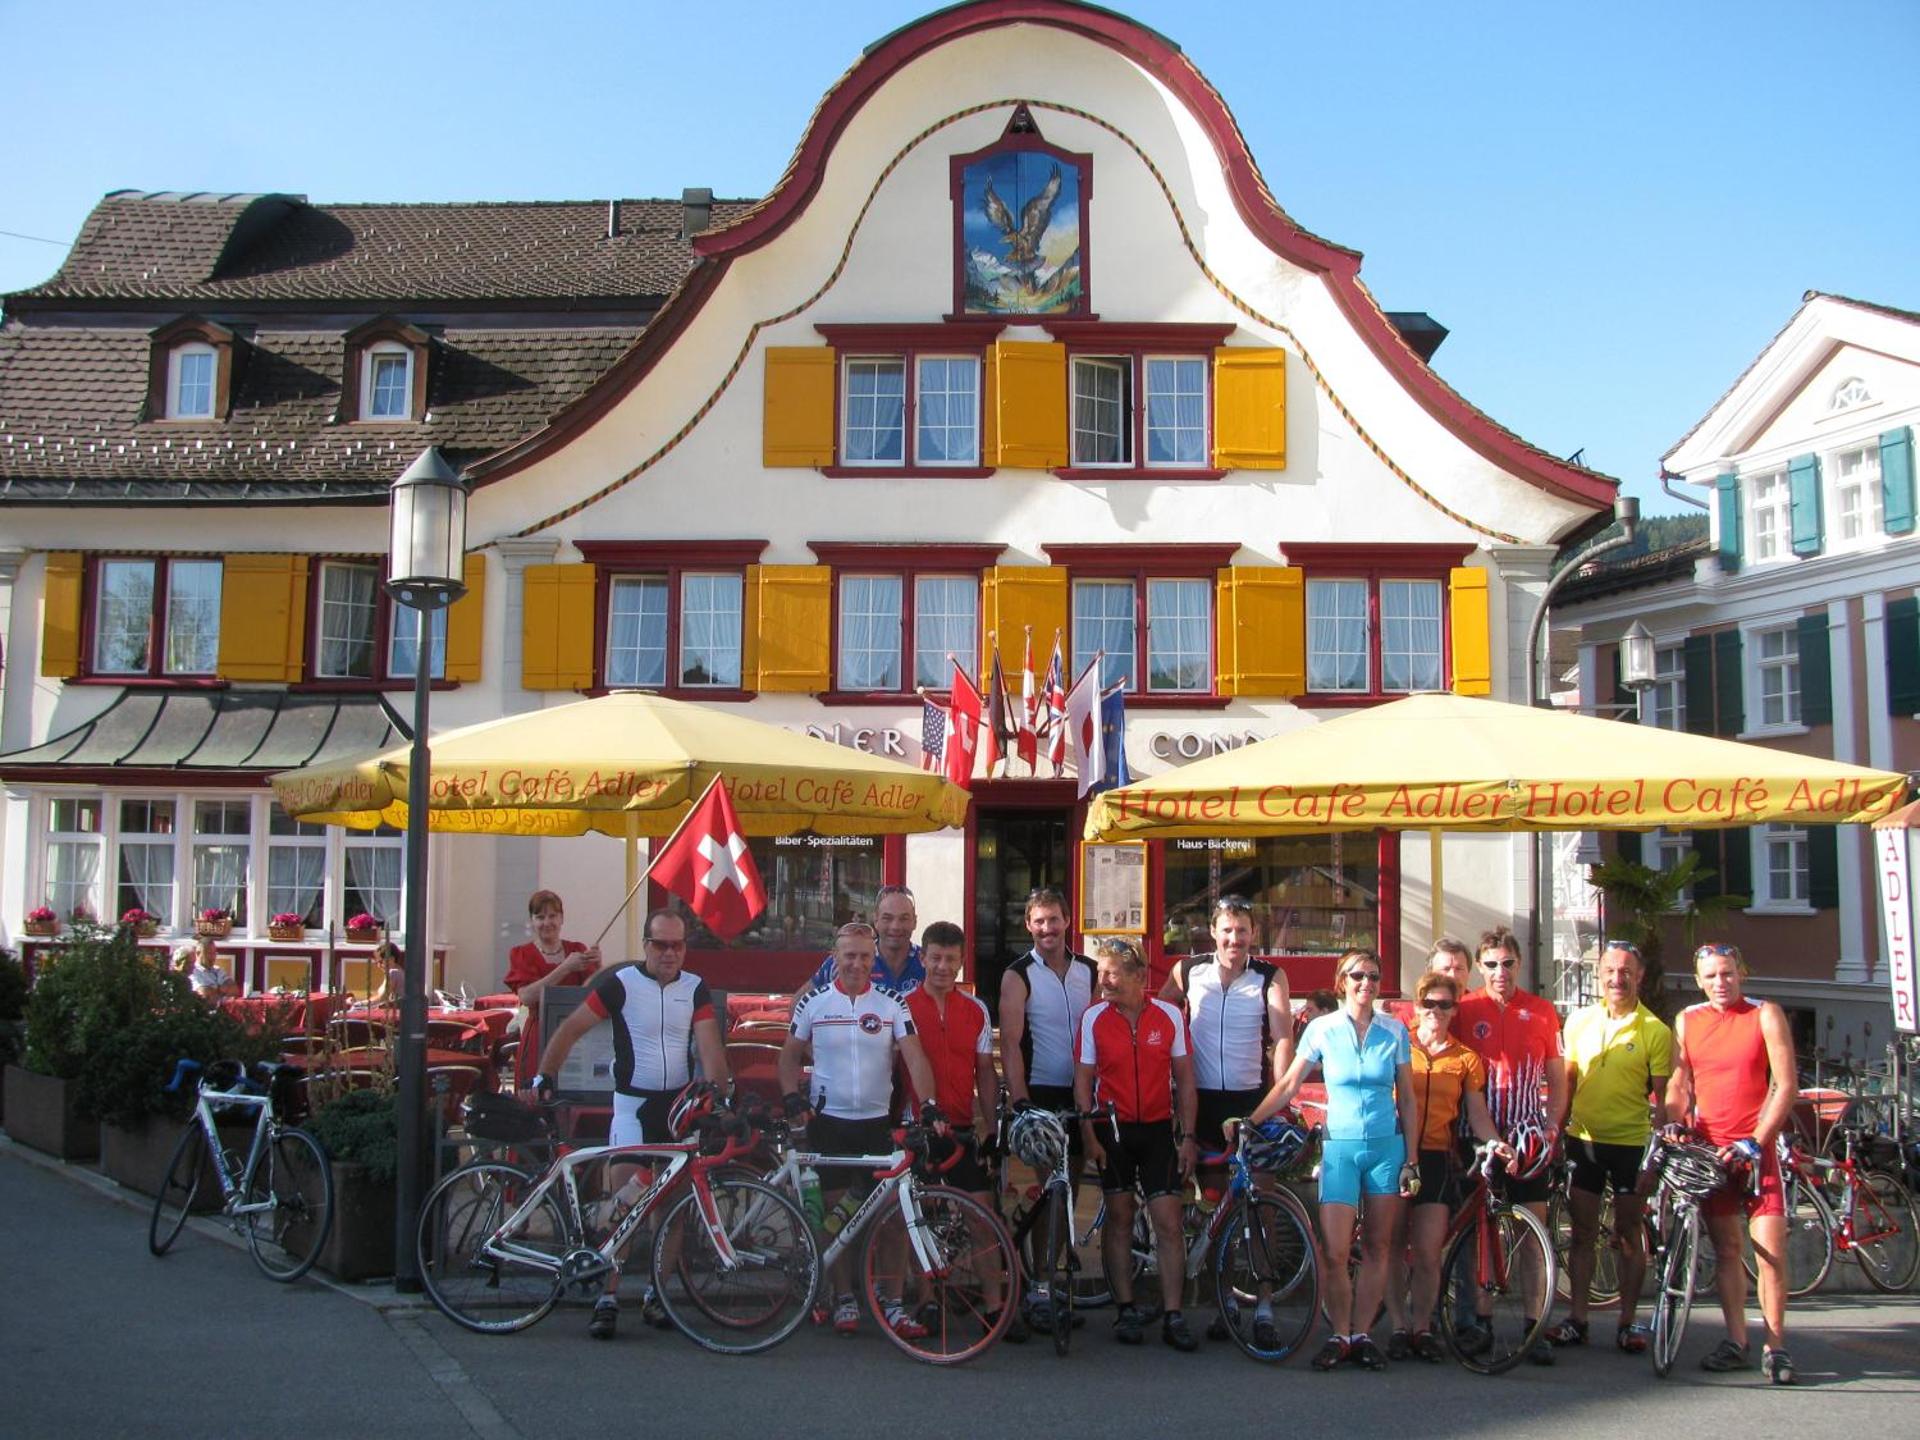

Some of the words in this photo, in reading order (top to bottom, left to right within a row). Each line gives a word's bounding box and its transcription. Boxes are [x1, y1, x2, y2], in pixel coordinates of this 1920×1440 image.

[784, 720, 906, 756] DLER
[431, 771, 487, 798] otel
[499, 769, 571, 801] Café
[584, 771, 674, 798] Adler
[796, 778, 854, 810] Café
[861, 783, 926, 811] Adler
[1116, 786, 1240, 822] Hotel
[1258, 784, 1367, 826] Café
[1380, 783, 1510, 818] Adler
[1525, 782, 1646, 818] Hotel
[1662, 777, 1770, 822] Café
[1784, 778, 1904, 814] Adler
[1884, 831, 1912, 1022] ADLER
